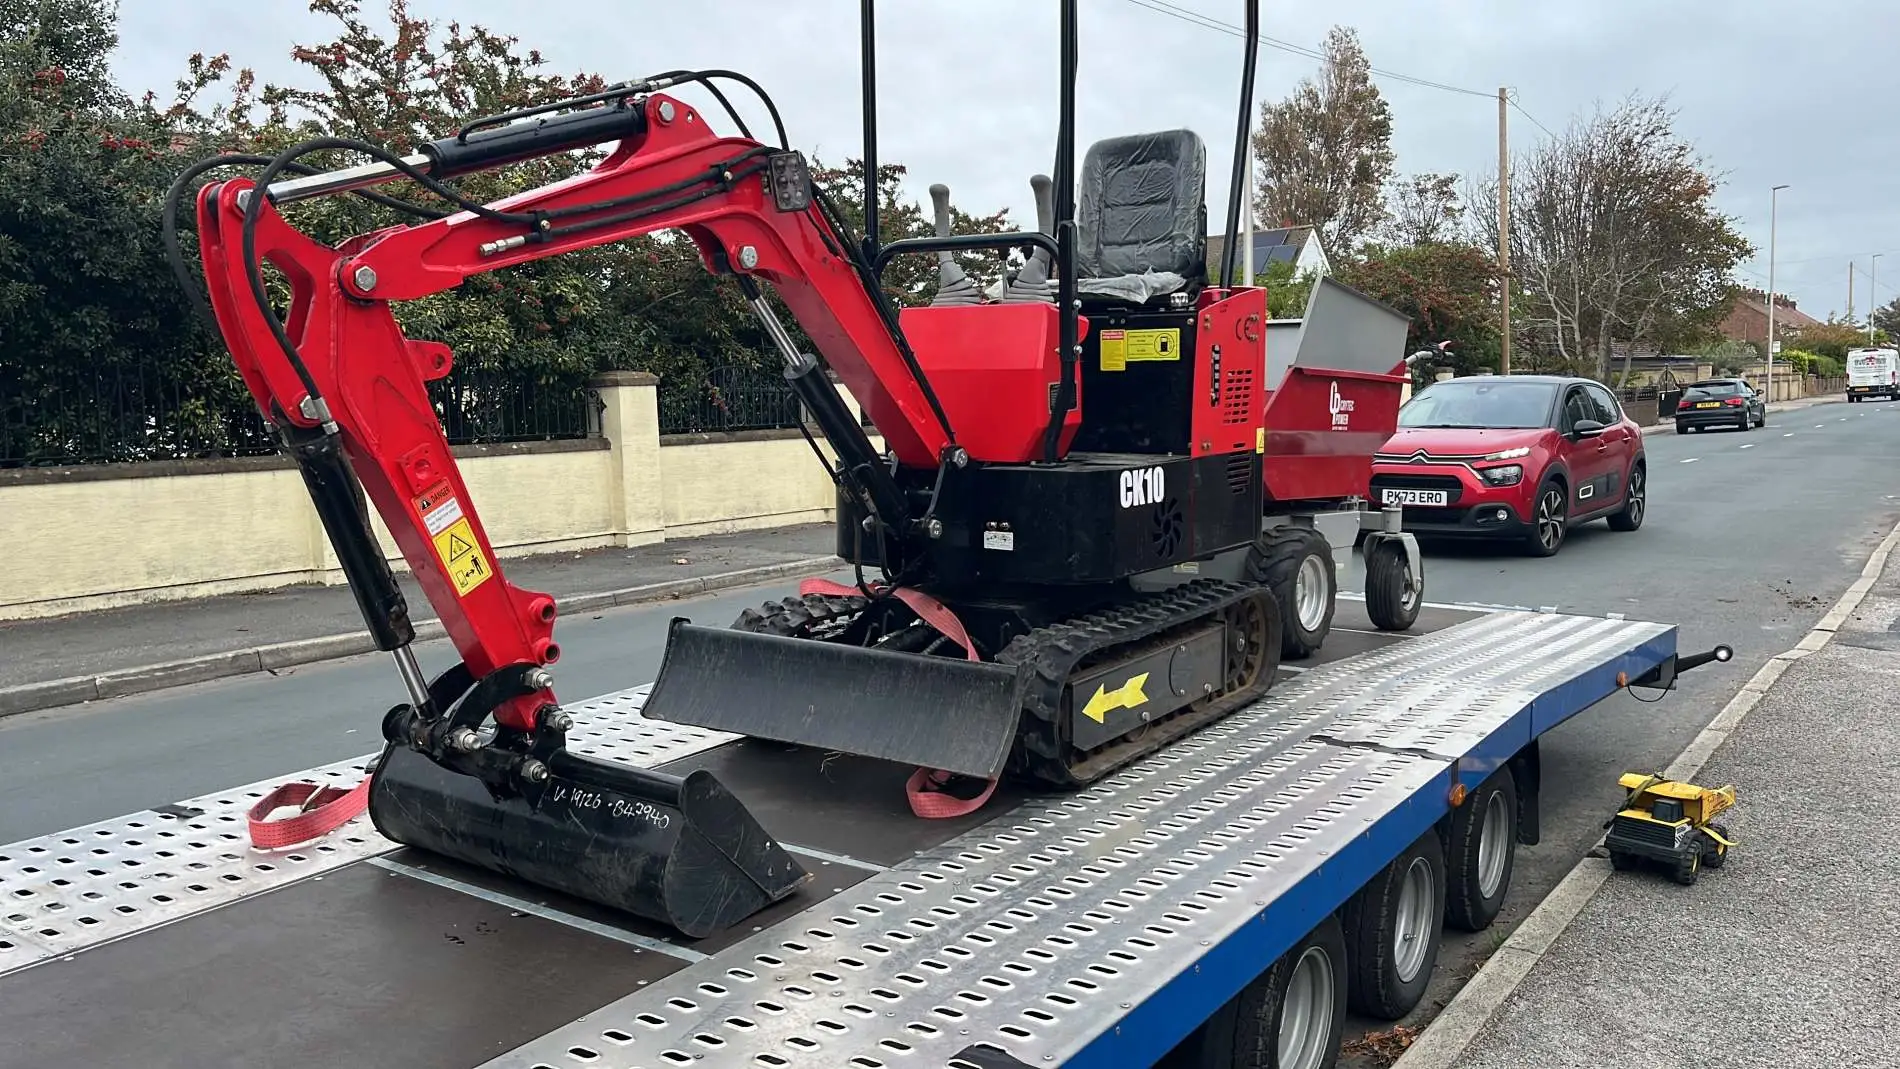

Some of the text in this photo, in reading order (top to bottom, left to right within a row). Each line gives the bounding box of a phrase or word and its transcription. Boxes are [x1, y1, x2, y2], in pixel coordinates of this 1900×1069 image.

[430, 486, 451, 504] DANGER
[1119, 466, 1165, 509] CK10
[1386, 491, 1416, 503] PK73
